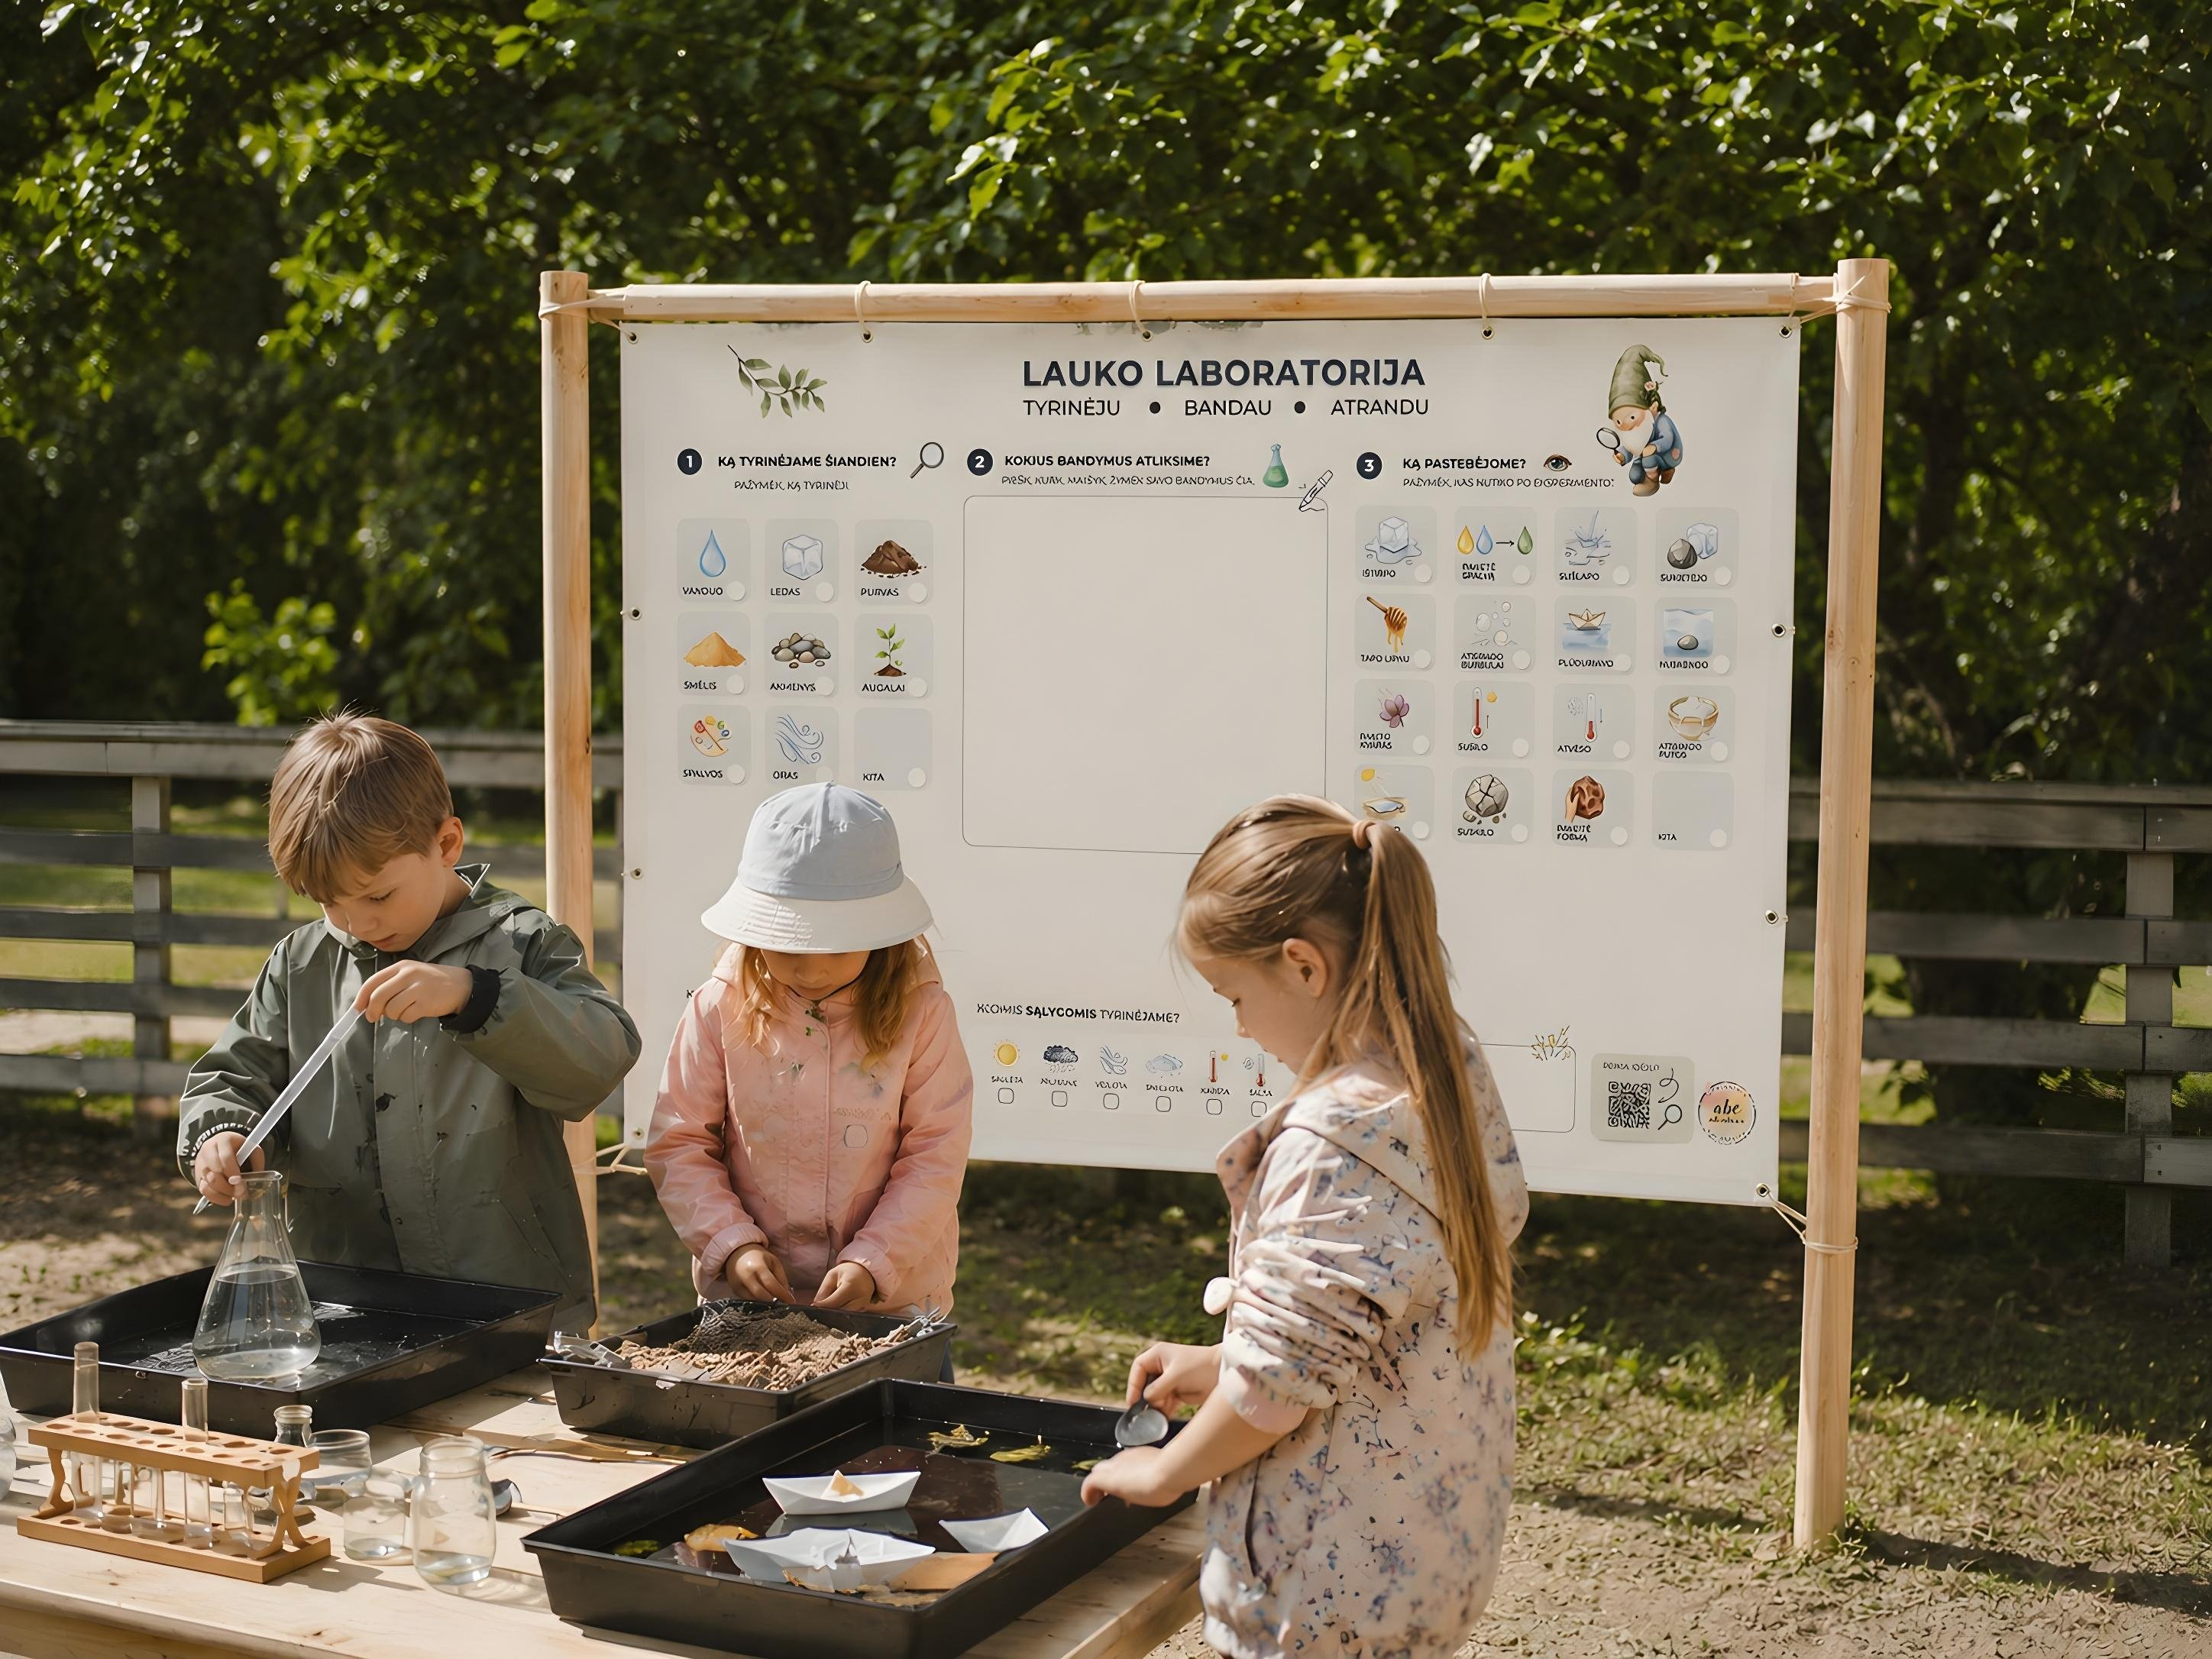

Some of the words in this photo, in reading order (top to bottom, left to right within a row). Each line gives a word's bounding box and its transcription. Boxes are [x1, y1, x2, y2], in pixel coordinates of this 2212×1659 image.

[1024, 361, 1143, 387] LAUKO
[1157, 359, 1426, 386] LABORATORIJA
[1023, 397, 1120, 416] TYRINĖJU
[1185, 400, 1271, 416] BANDAU
[1331, 399, 1428, 416] ATRANDU
[719, 457, 736, 469] KĄ
[826, 454, 897, 467] ŠIANDIEN?
[1058, 456, 1132, 466] BANDYMUS
[1136, 456, 1210, 466] ATLIKSIME?
[1403, 458, 1421, 471] KĄ
